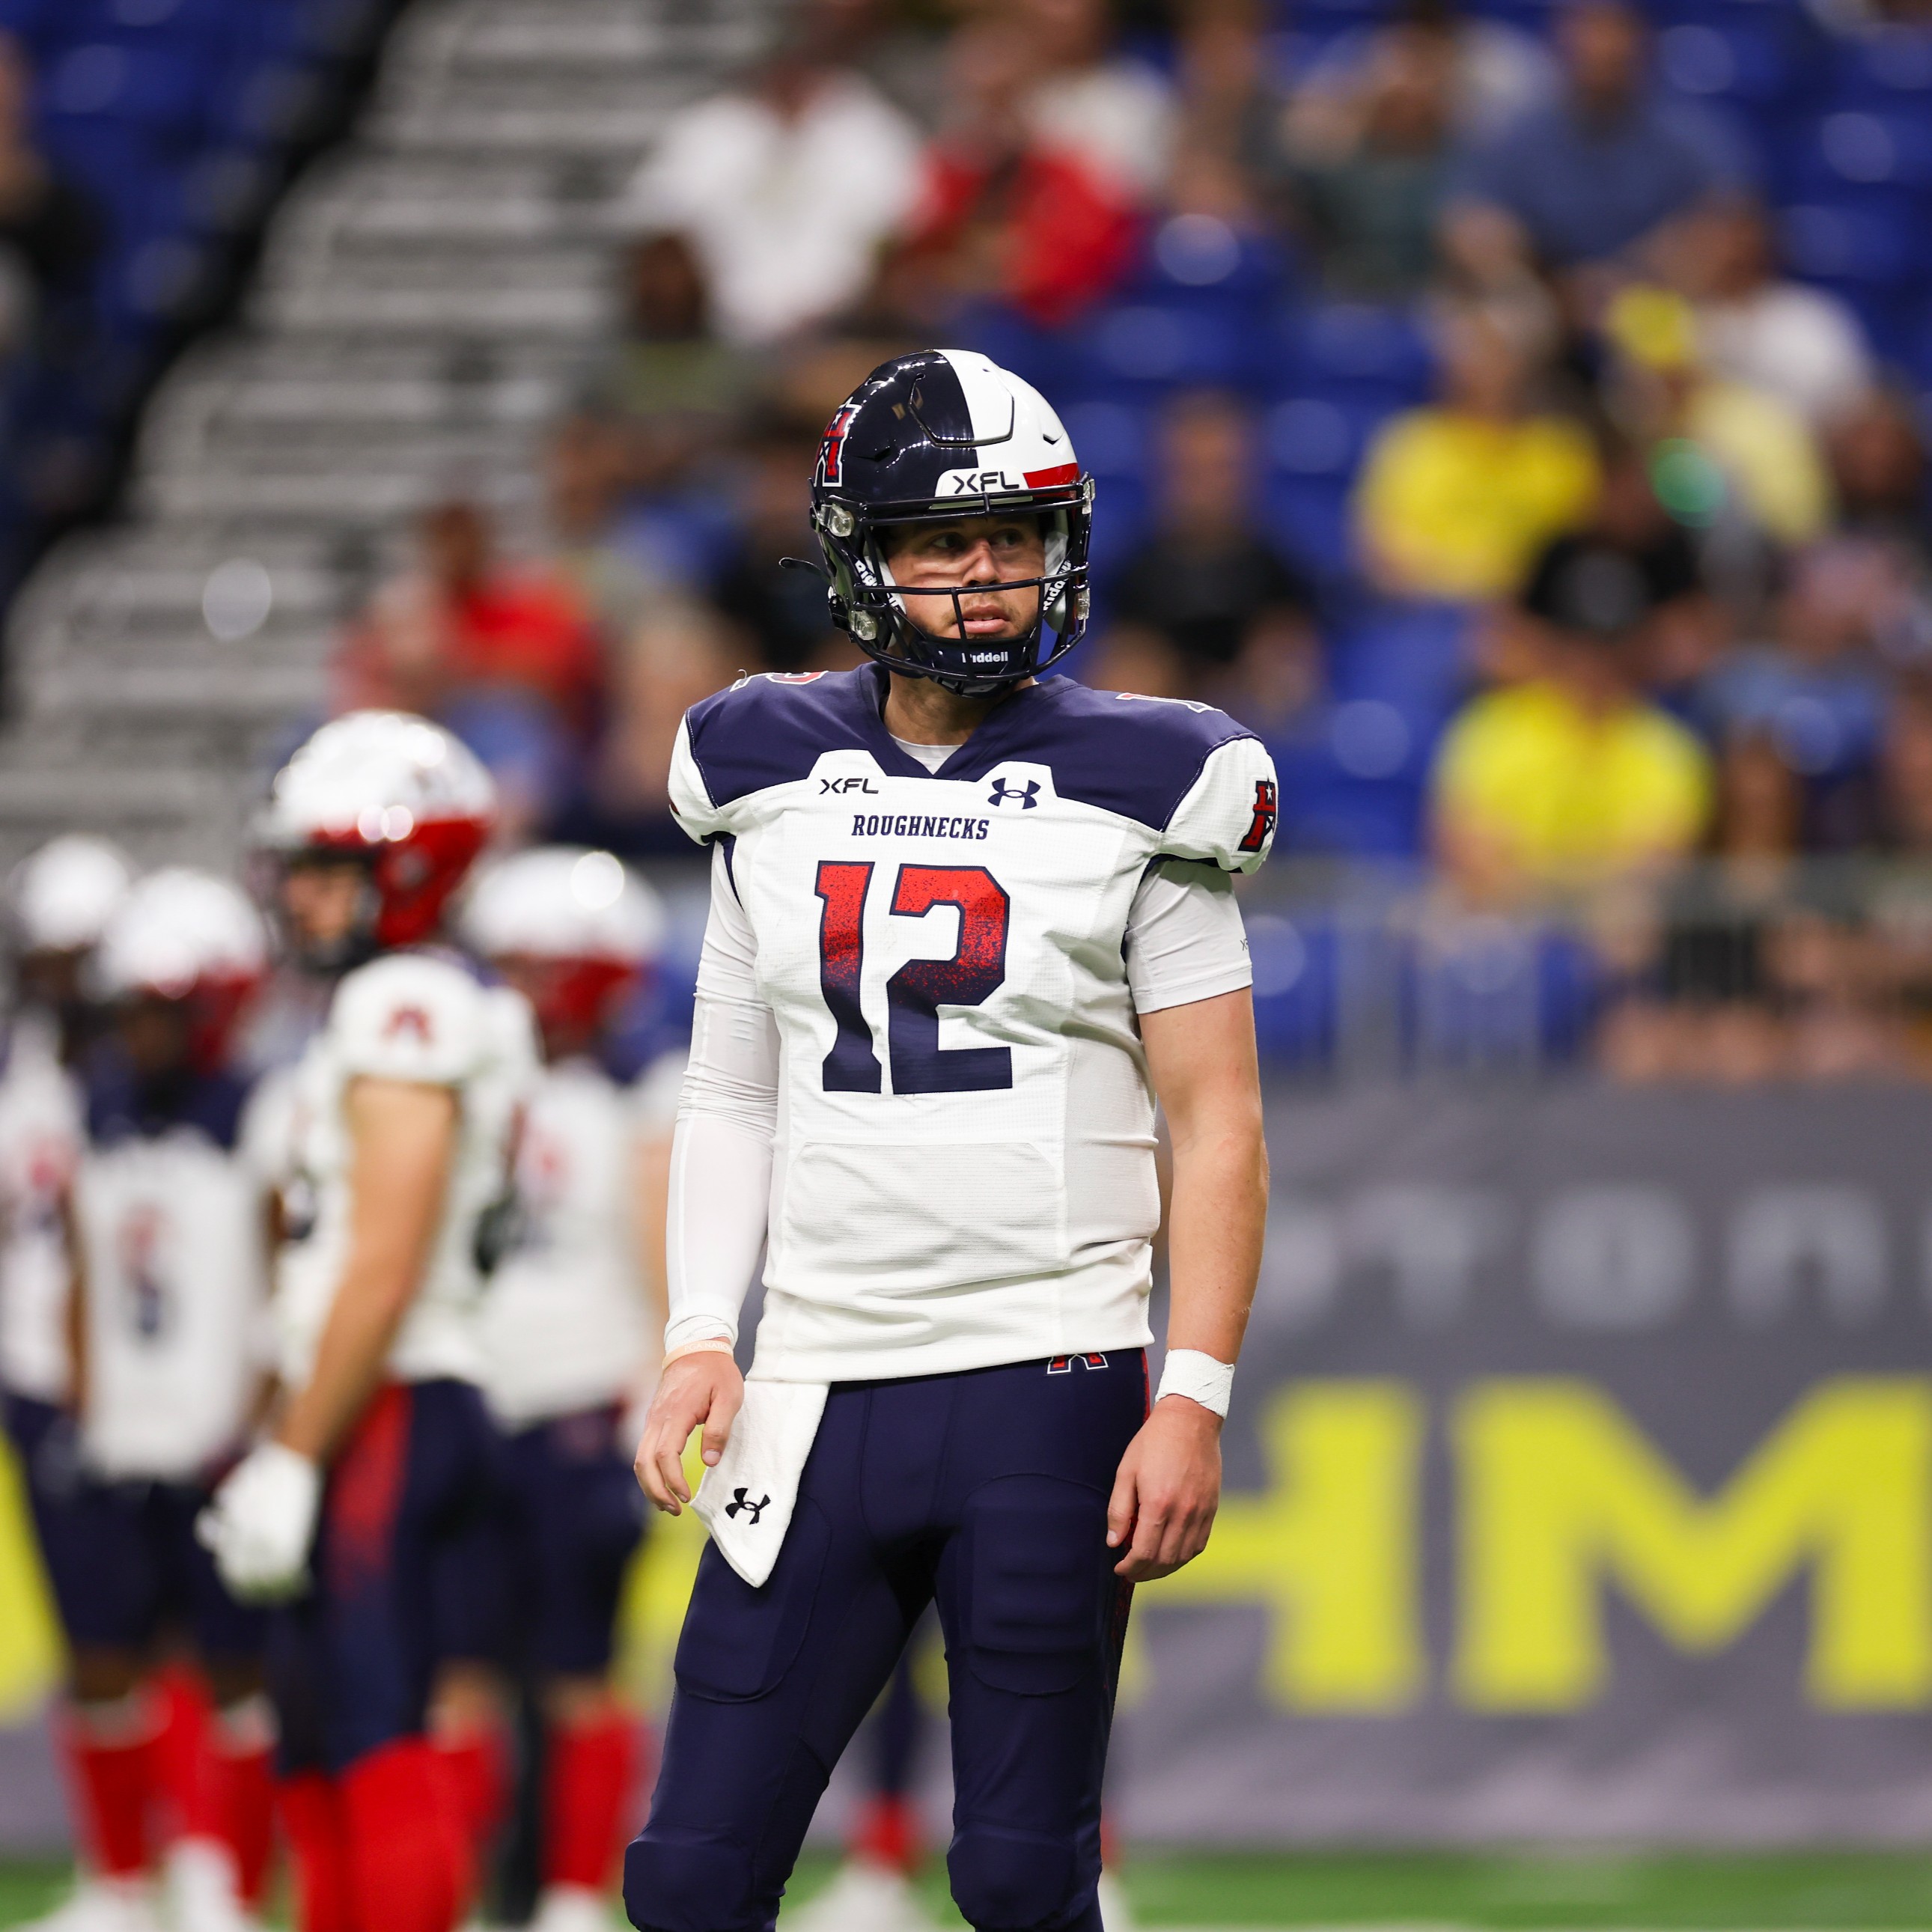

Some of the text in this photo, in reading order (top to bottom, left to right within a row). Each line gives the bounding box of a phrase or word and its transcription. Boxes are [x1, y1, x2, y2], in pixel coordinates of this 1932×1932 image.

[952, 471, 1020, 494] XFL
[819, 778, 879, 795] XFL
[851, 814, 990, 840] ROUGHNECKS
[814, 861, 1013, 1095] 12
